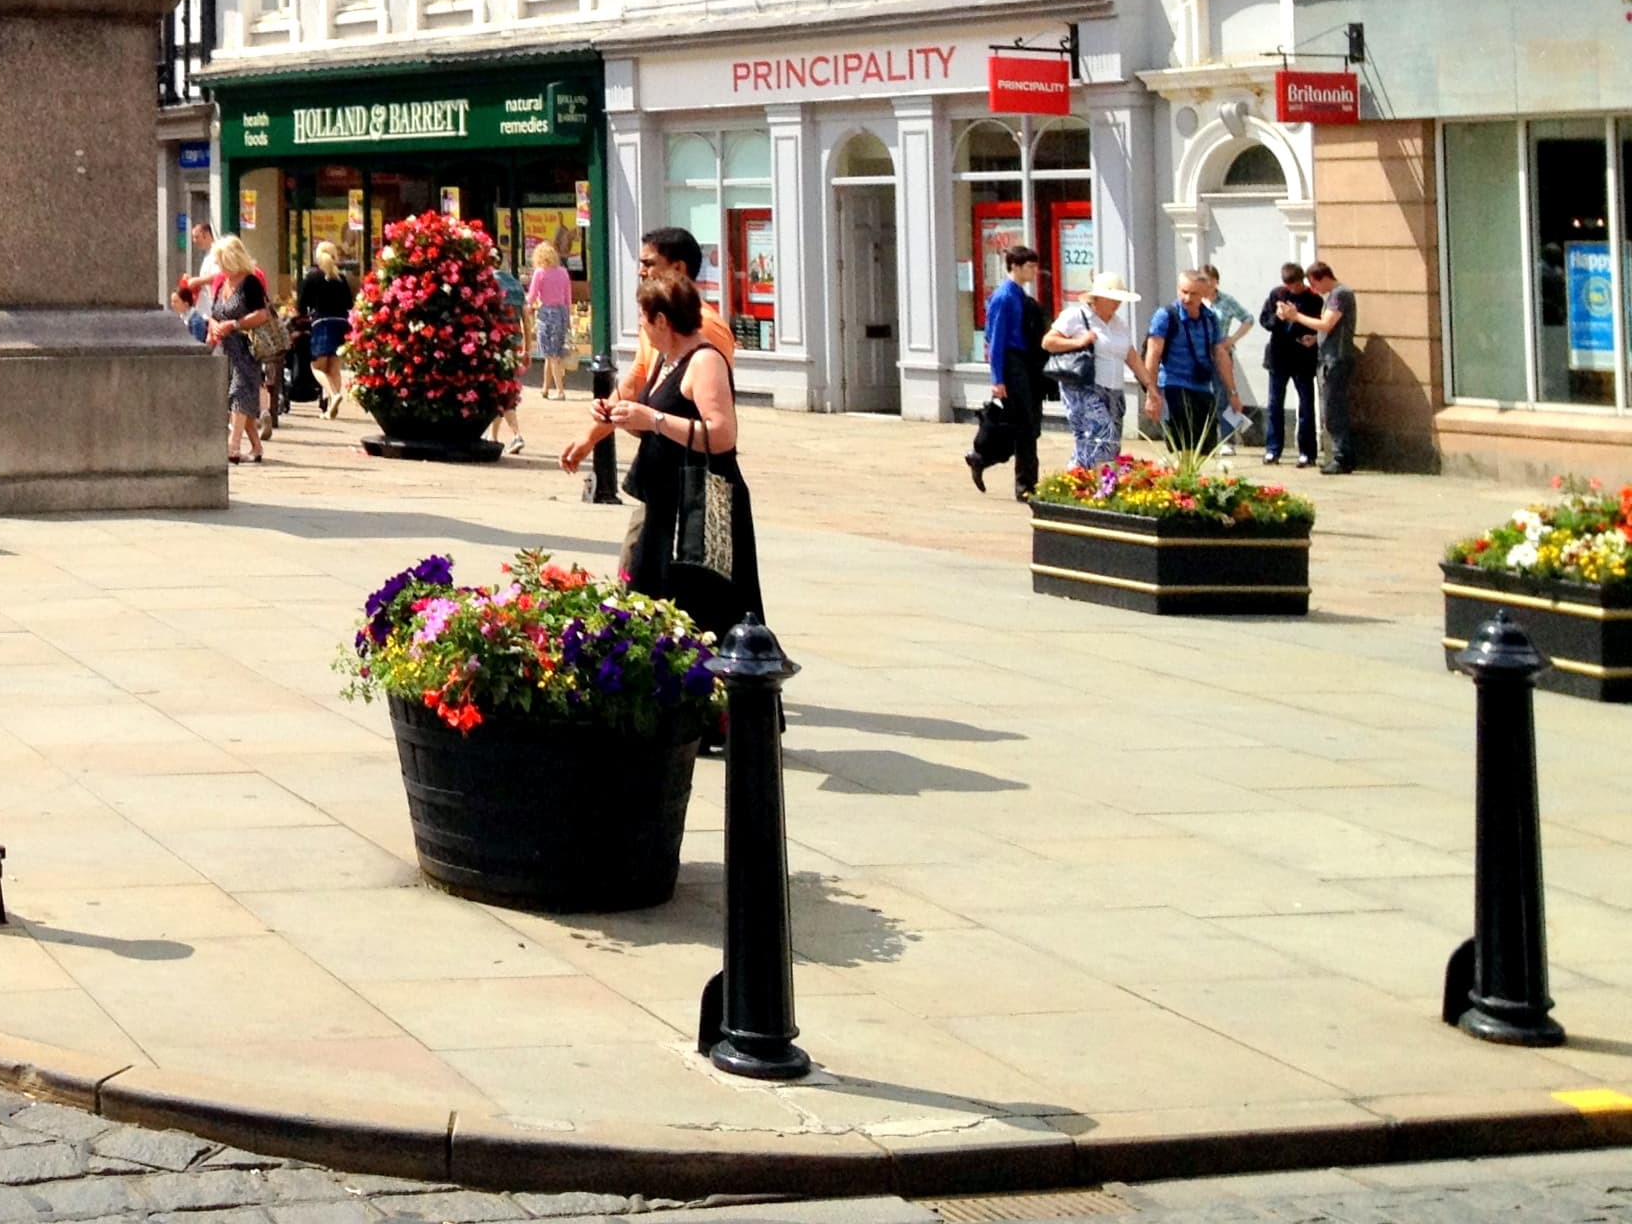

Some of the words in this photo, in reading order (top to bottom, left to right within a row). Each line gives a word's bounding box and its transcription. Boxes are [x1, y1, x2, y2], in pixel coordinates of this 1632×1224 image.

[732, 46, 956, 92] PRINCIPALITY
[997, 79, 1065, 94] PRINCIPALITY
[1288, 84, 1355, 104] Britannia
[505, 93, 543, 112] natural
[243, 112, 270, 127] health
[293, 105, 369, 144] HOLLAND
[369, 104, 387, 140] &
[388, 99, 469, 136] BARRETT
[500, 115, 549, 134] remedies
[244, 130, 269, 146] foods
